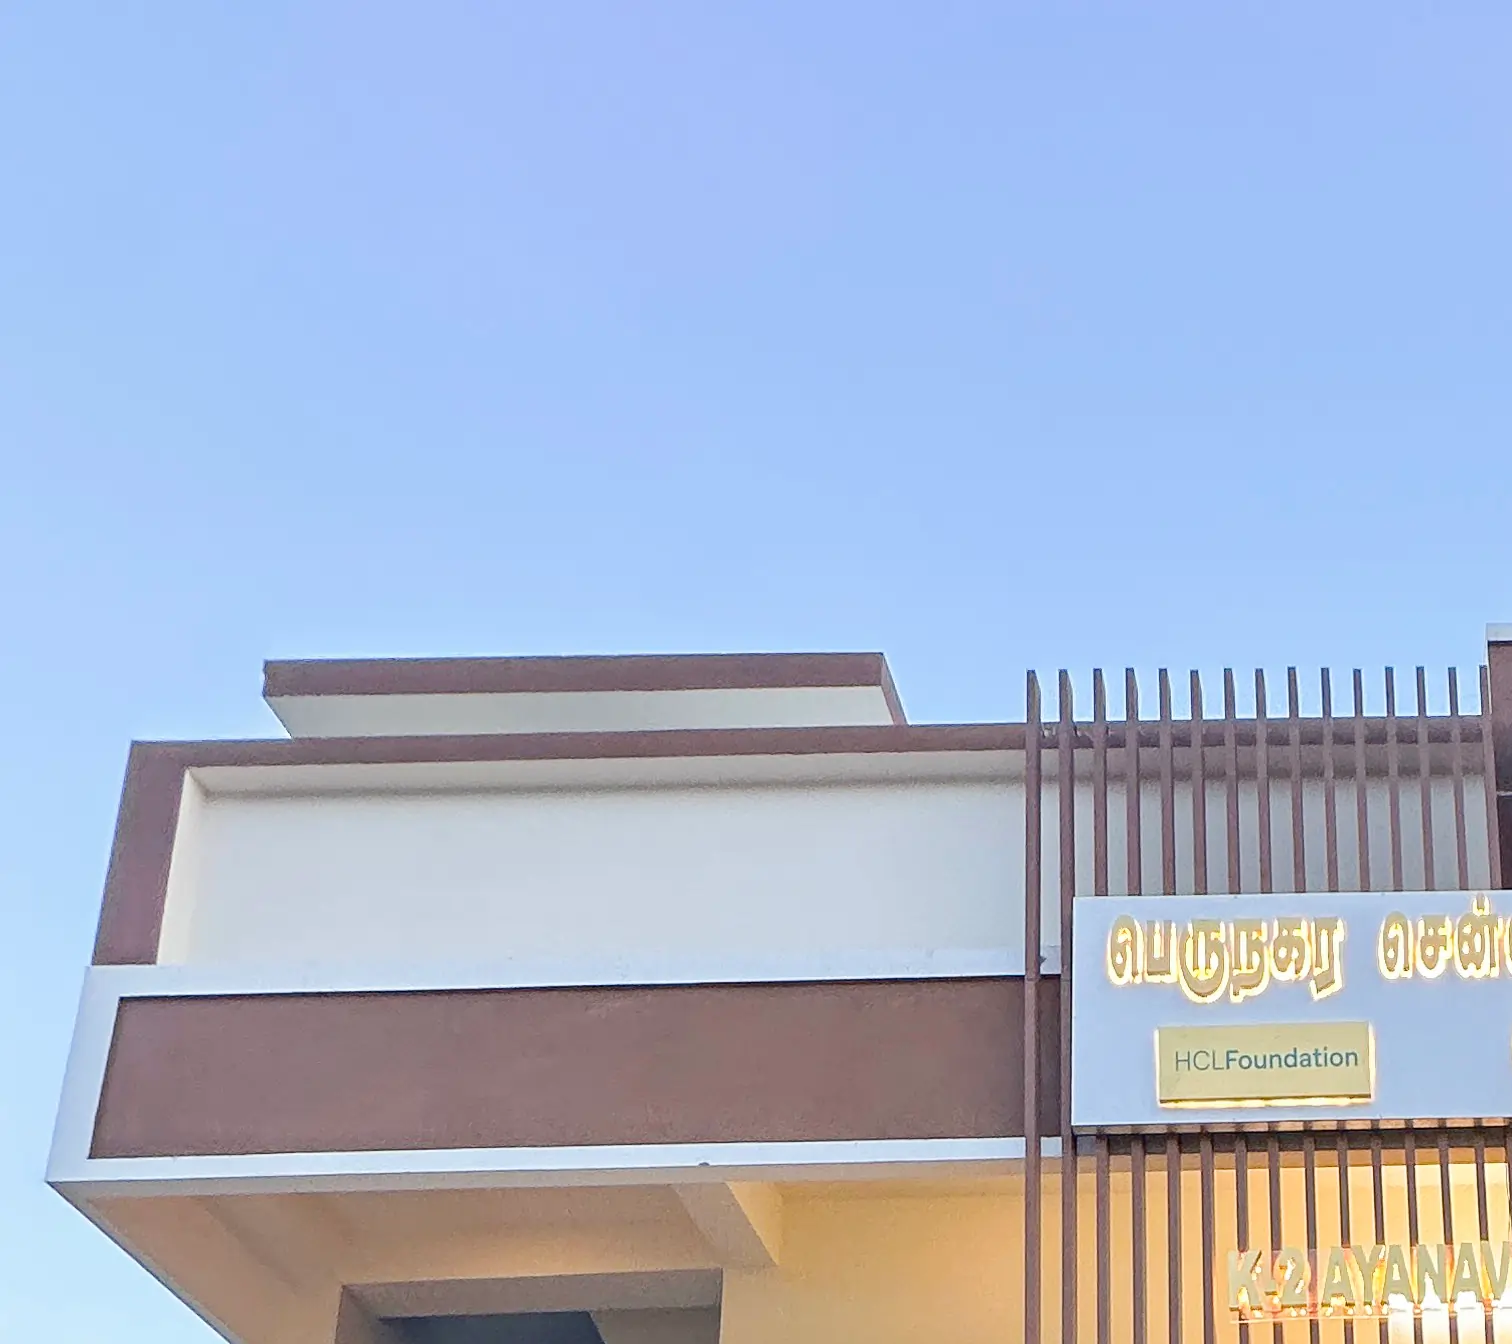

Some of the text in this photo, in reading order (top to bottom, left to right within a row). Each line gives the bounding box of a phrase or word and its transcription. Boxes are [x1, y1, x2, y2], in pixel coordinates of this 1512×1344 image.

[1109, 914, 1342, 1000] பெருநகர
[1175, 1046, 1359, 1071] HCLFoundation
[1229, 1248, 1308, 1310] K-2
